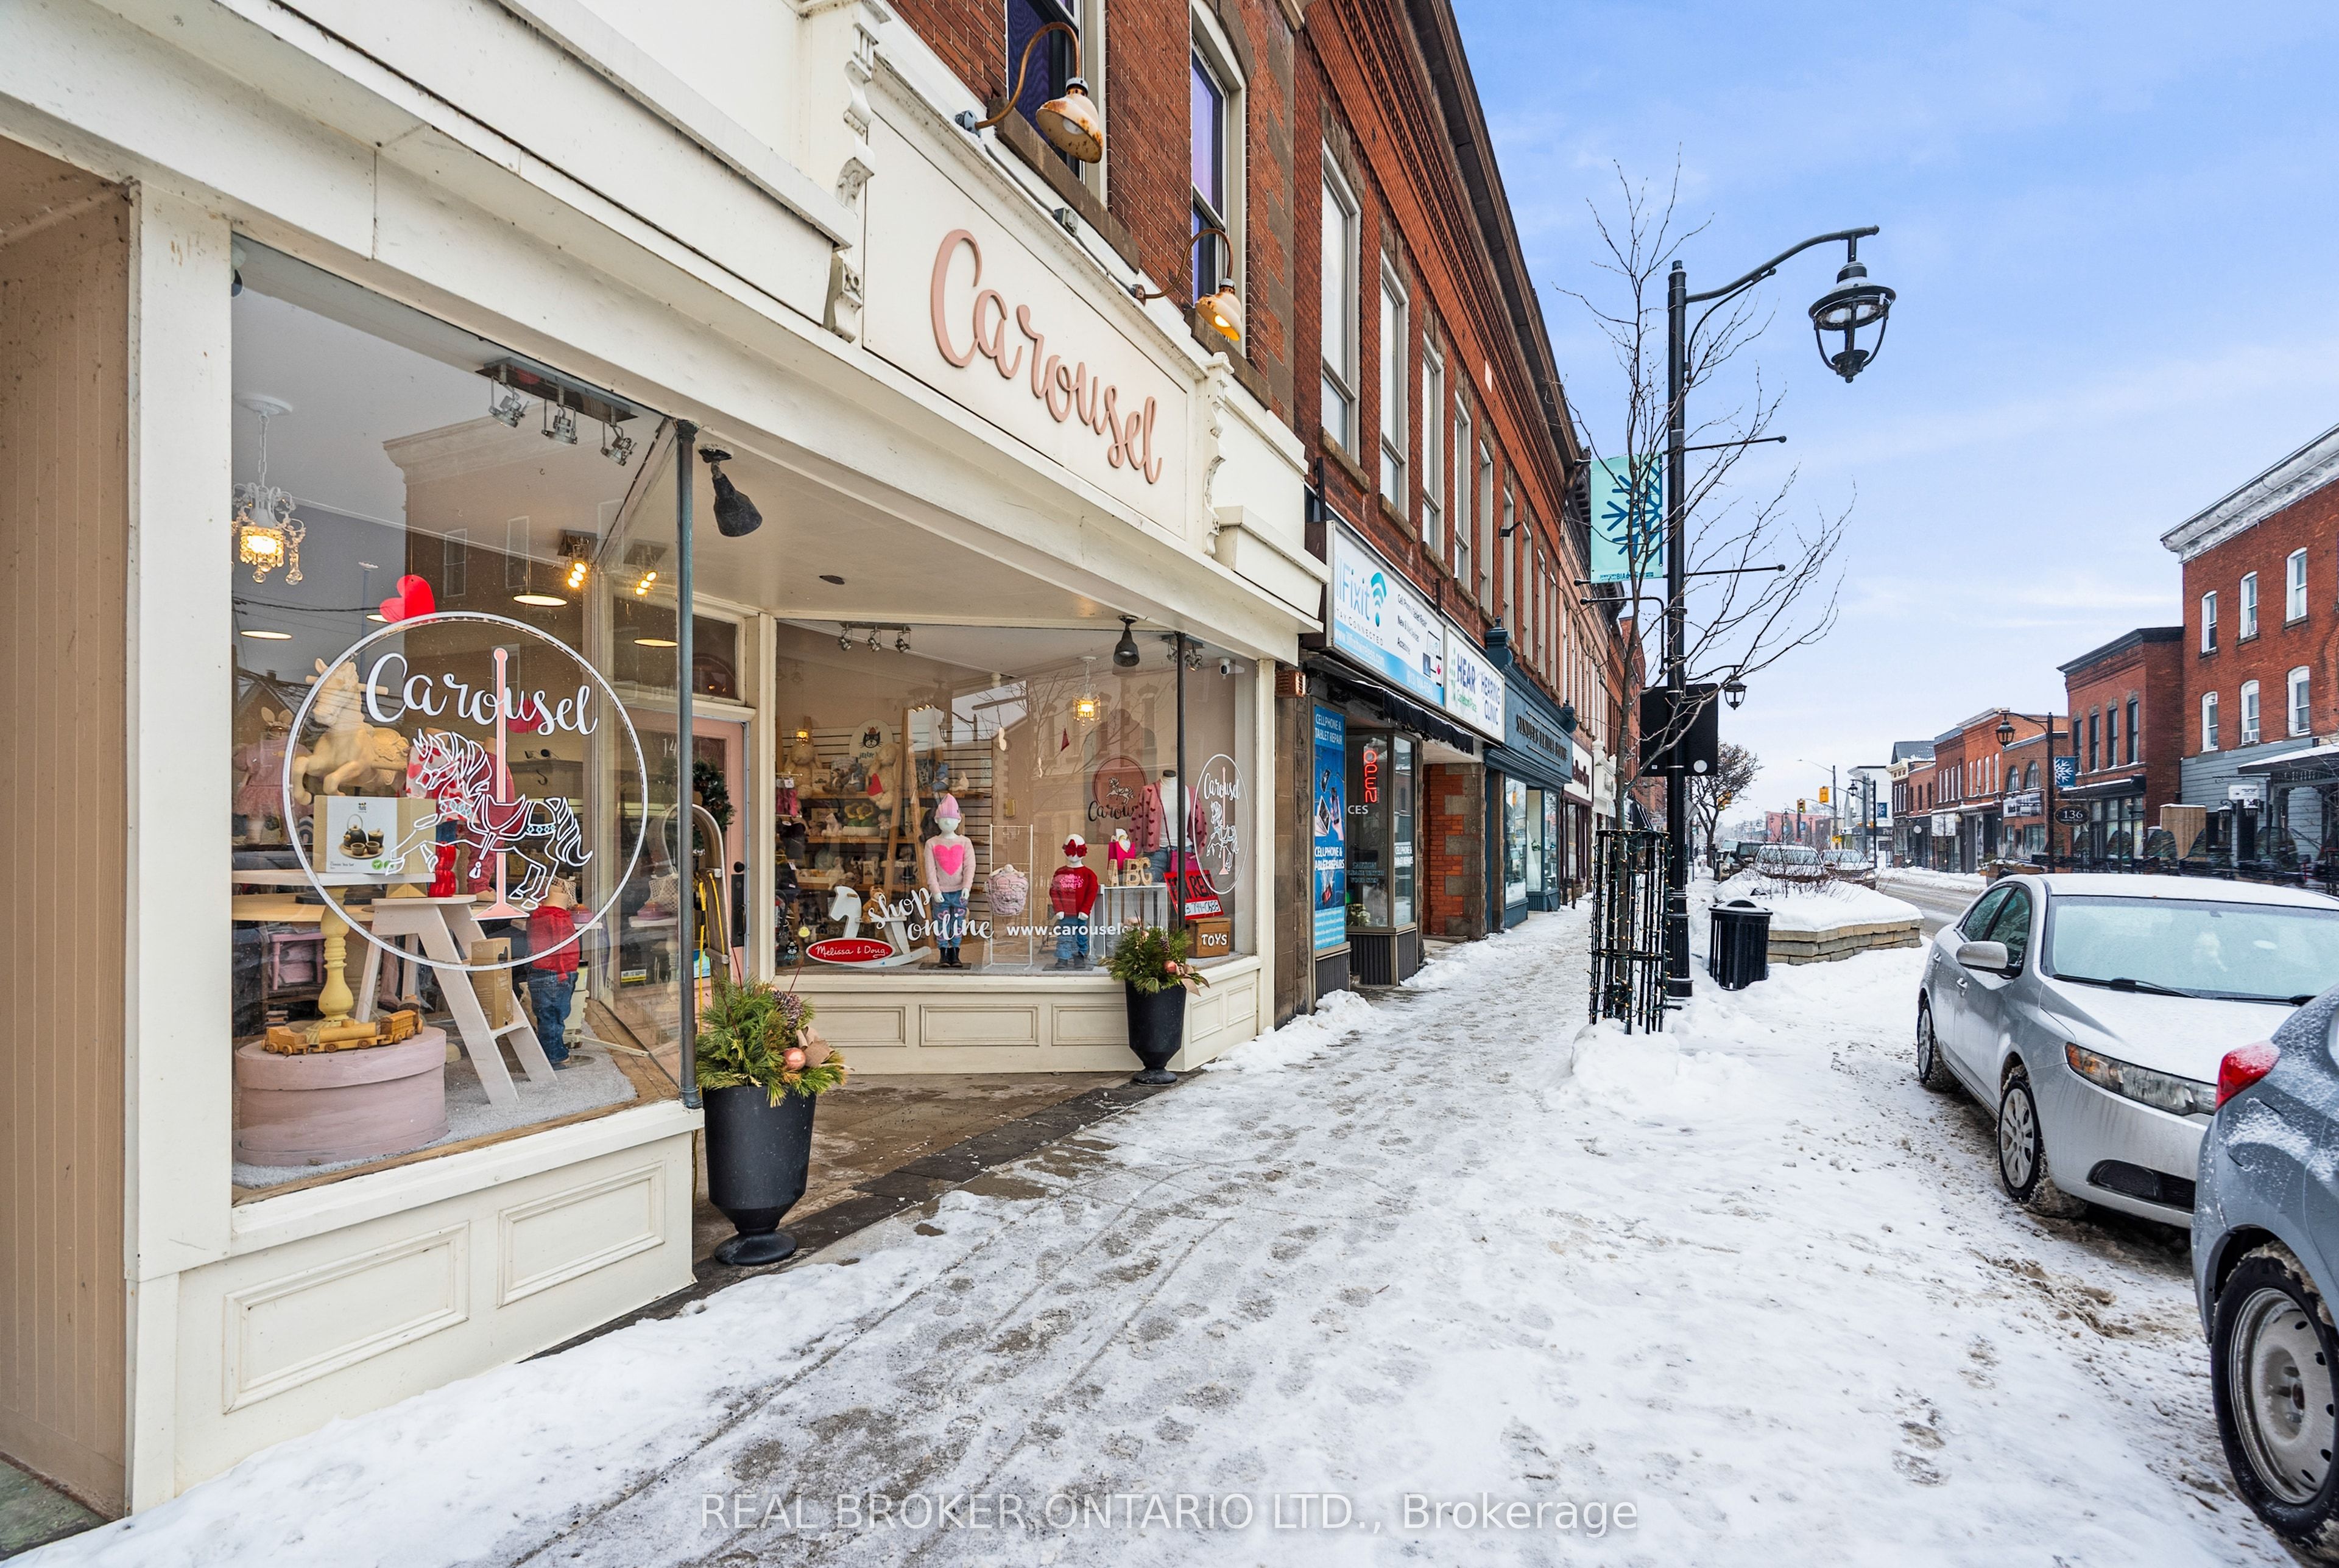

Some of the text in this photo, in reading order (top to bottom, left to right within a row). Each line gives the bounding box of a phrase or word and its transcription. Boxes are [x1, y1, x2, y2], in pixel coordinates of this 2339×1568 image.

[930, 229, 1162, 484] Carousel
[1348, 616, 1383, 647] CONNECTED
[1457, 653, 1475, 694] HEAR
[367, 653, 598, 736] Carousel
[1204, 772, 1241, 801] Carousel
[1363, 750, 1378, 803] OPEN
[1088, 800, 1135, 822] Carou
[2063, 810, 2083, 819] 136
[1314, 846, 1339, 857] CELLPHONE
[868, 887, 932, 929] shop
[907, 913, 995, 941] online
[1201, 933, 1222, 947] TOYS
[815, 945, 854, 958] Melissa
[864, 946, 886, 958] Doug
